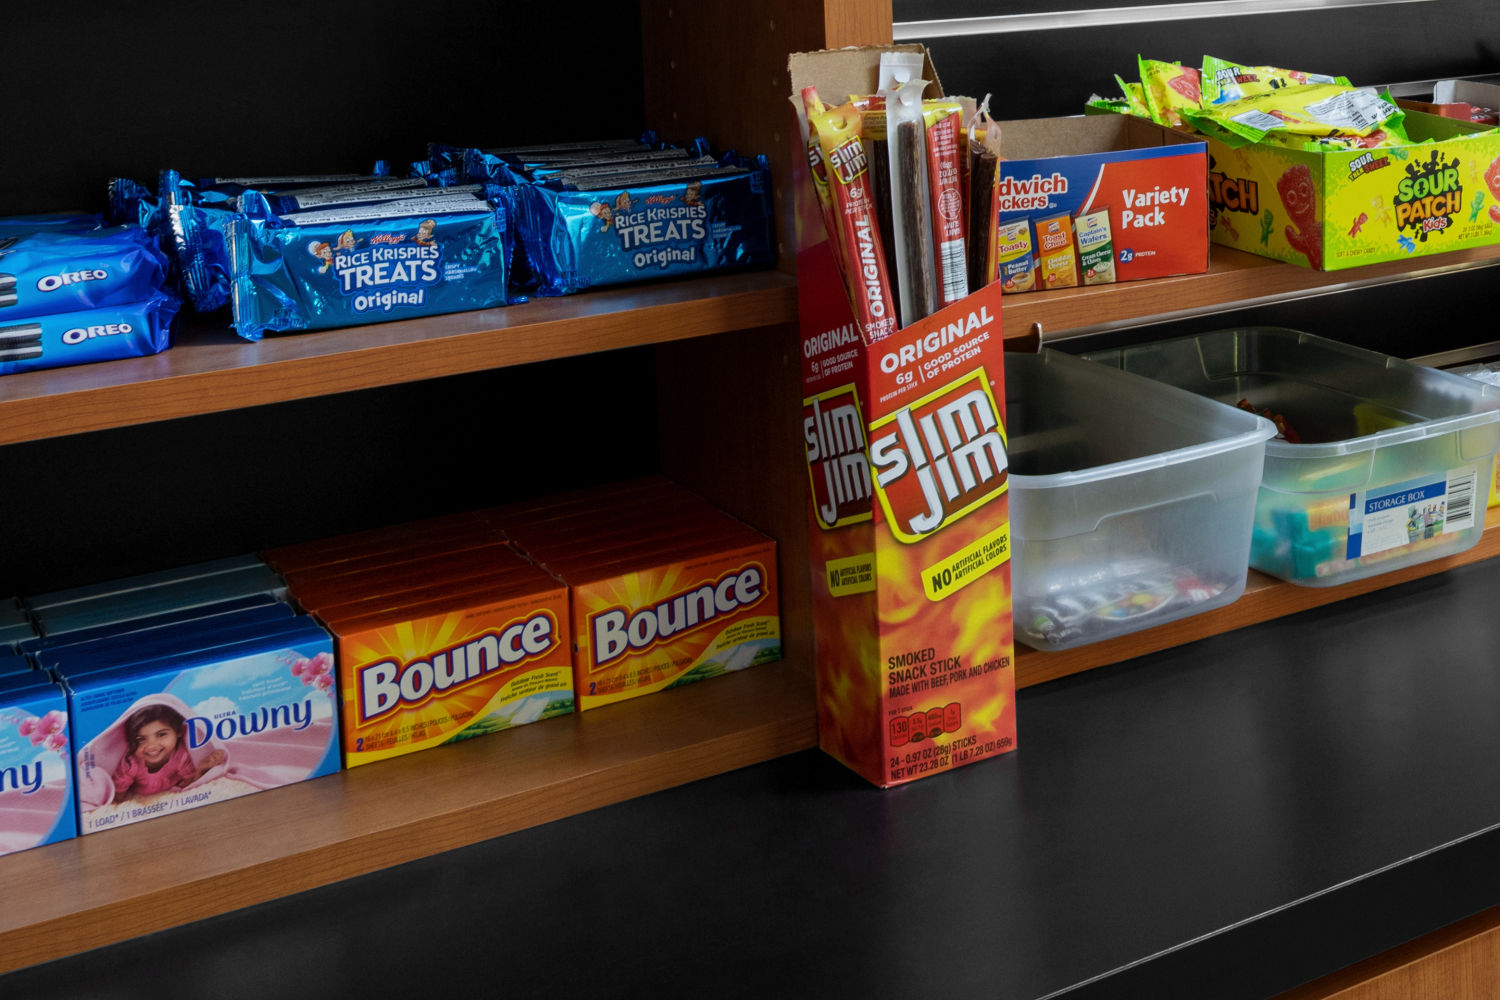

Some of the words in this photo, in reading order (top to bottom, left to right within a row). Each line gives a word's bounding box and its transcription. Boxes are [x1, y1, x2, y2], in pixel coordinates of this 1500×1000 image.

[1349, 152, 1373, 172] SOUR
[850, 186, 863, 198] 6g
[1399, 168, 1459, 202] SOUR
[1122, 186, 1190, 208] Variety
[615, 212, 645, 229] RICE
[647, 204, 706, 222] KRISPIES
[1122, 209, 1165, 230] Pack
[1396, 191, 1461, 227] PATCH
[619, 219, 706, 248] TREATS
[1079, 227, 1107, 238] Captain's
[1422, 217, 1447, 233] Kids
[999, 241, 1028, 254] Toasty
[1044, 231, 1065, 242] Toast
[1080, 234, 1107, 245] Wafers
[335, 251, 370, 270] RICE
[372, 245, 440, 262] KRISPIES
[634, 247, 695, 267] Original
[856, 213, 885, 317] ORIGINAL
[1007, 260, 1029, 269] Peanut
[1120, 249, 1133, 262] 2g
[1135, 250, 1156, 258] PROTEIN
[37, 269, 108, 292] OREO
[338, 259, 437, 291] TREATS
[1007, 266, 1028, 275] Butter
[354, 289, 424, 311] Original
[62, 323, 133, 345] OREO
[865, 317, 894, 332] SMOKED
[804, 324, 858, 358] ORIGINAL
[880, 306, 993, 373] ORIGINAL
[823, 357, 836, 368] GOOD
[837, 348, 858, 362] SOURCE
[924, 355, 949, 371] GOOD
[952, 331, 990, 355] SOURCE
[811, 360, 819, 373] 6g
[927, 369, 938, 379] OF
[940, 347, 982, 370] PROTEIN
[896, 369, 913, 384] 6g
[1368, 494, 1406, 513] STORAGE
[1407, 489, 1426, 502] BOX
[952, 551, 982, 573] ARTIFICIAL
[983, 534, 1008, 556] FLAVORS
[954, 559, 984, 580] ARTIFICIAL
[986, 545, 1007, 562] COLORS
[830, 570, 840, 588] NO
[932, 568, 952, 593] NO
[594, 568, 762, 664] Bounce
[362, 615, 551, 720] Bounce
[888, 647, 936, 670] SMOKED
[888, 664, 927, 685] SNACK
[930, 655, 961, 675] STICK
[889, 685, 910, 698] MADE
[912, 680, 929, 694] WITH
[931, 675, 949, 689] BEEF,
[950, 669, 967, 683] PORK
[969, 665, 982, 677] AND
[983, 656, 1010, 674] CHICKEN
[186, 699, 313, 750] Downy
[213, 710, 236, 720] ULTRA
[892, 721, 907, 733] 130
[356, 738, 364, 751] 2
[890, 757, 899, 768] 24
[906, 752, 920, 764] 0.97
[922, 749, 932, 760] OZ
[933, 744, 951, 758] (28g)
[952, 735, 977, 751] STICKS
[891, 767, 906, 780] NET
[907, 764, 918, 776] WT
[919, 759, 939, 772] 23.28
[940, 756, 949, 768] OZ
[952, 753, 958, 764] (1
[959, 750, 968, 761] LB
[970, 746, 984, 759] 7.28
[985, 743, 995, 753] OZ)
